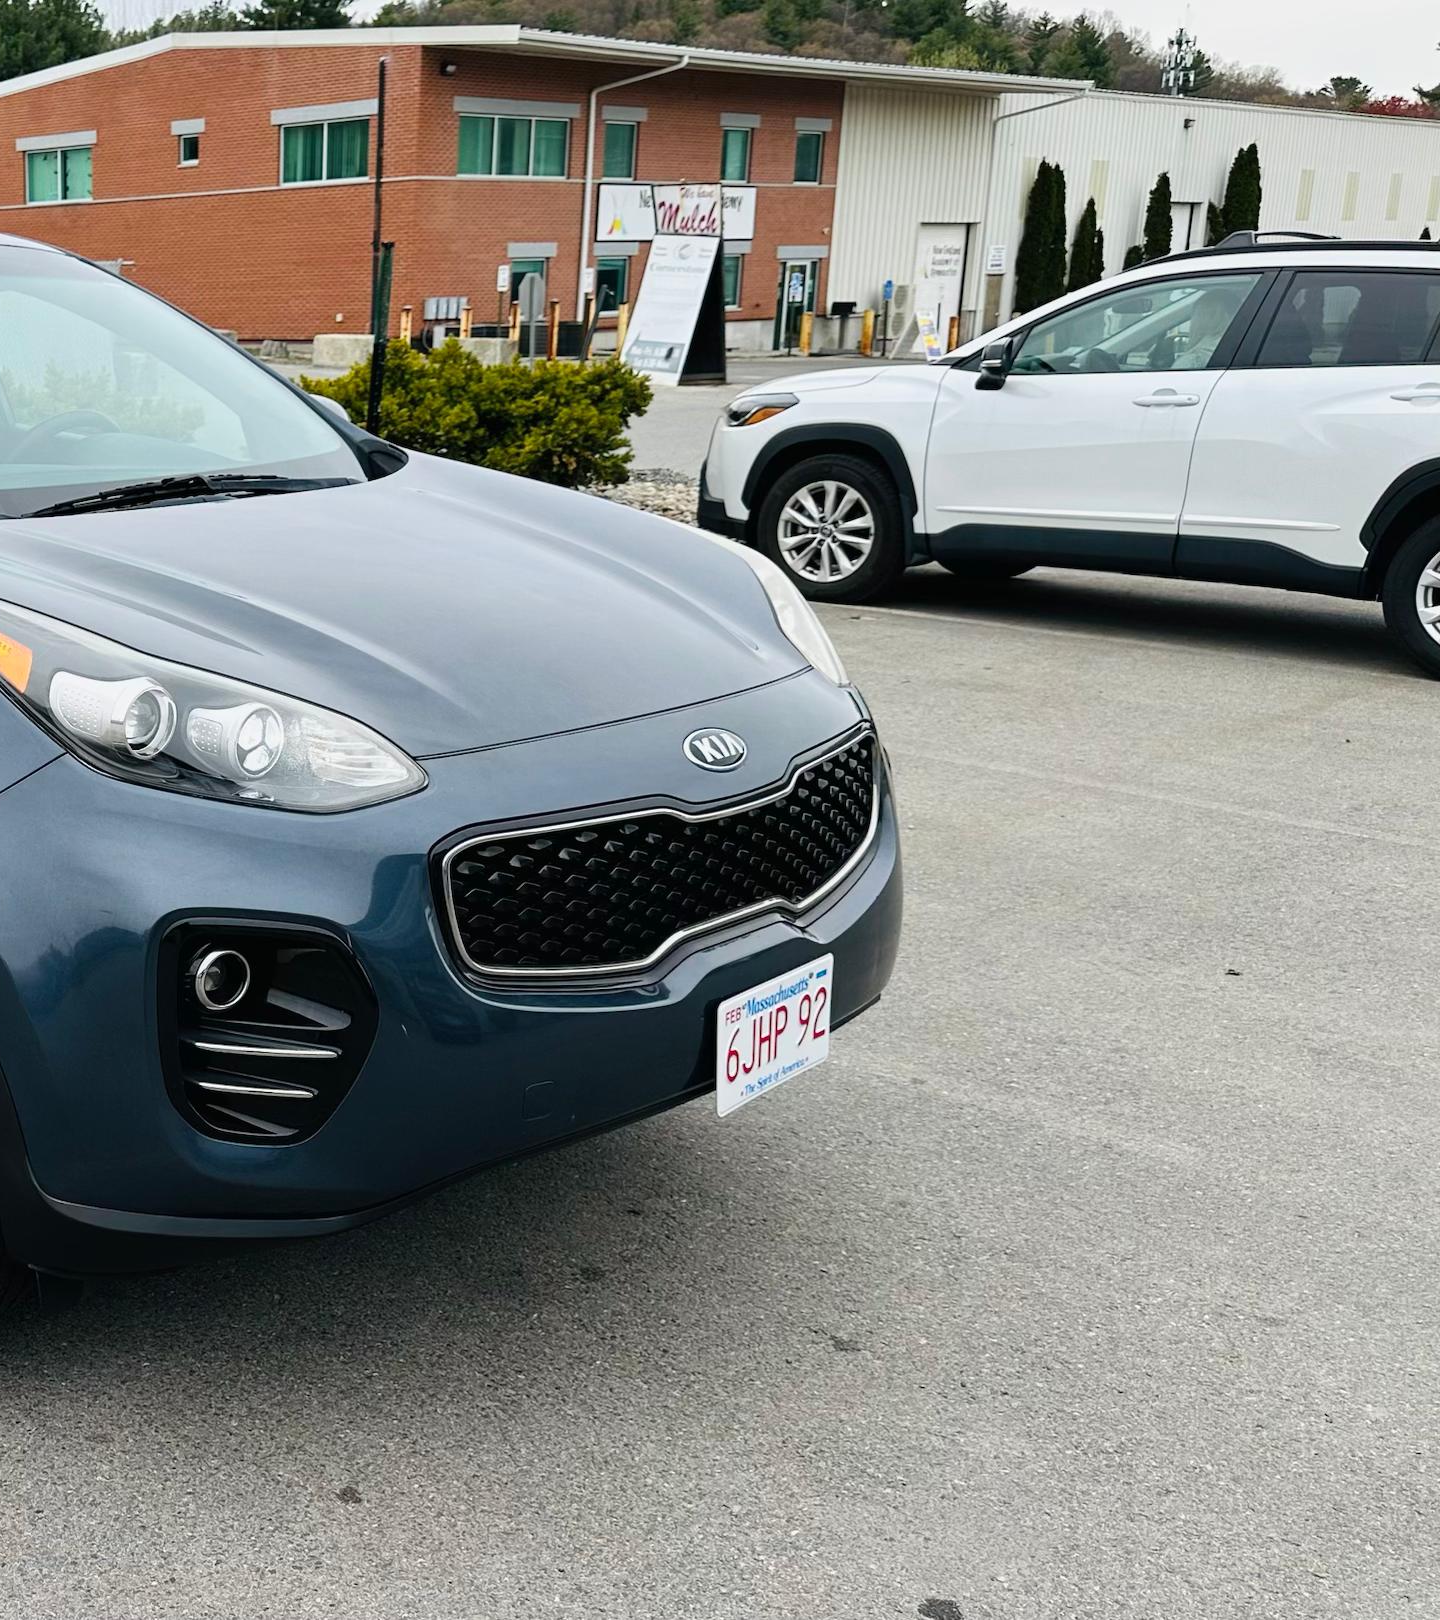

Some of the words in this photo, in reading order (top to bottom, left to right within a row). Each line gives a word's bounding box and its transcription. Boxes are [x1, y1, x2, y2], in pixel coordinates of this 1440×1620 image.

[658, 201, 718, 233] Mulch
[692, 733, 744, 763] KIA
[746, 977, 809, 1018] Massachusetts
[725, 1007, 741, 1027] FEB
[745, 1084, 760, 1096] The
[758, 1074, 773, 1088] Spirit
